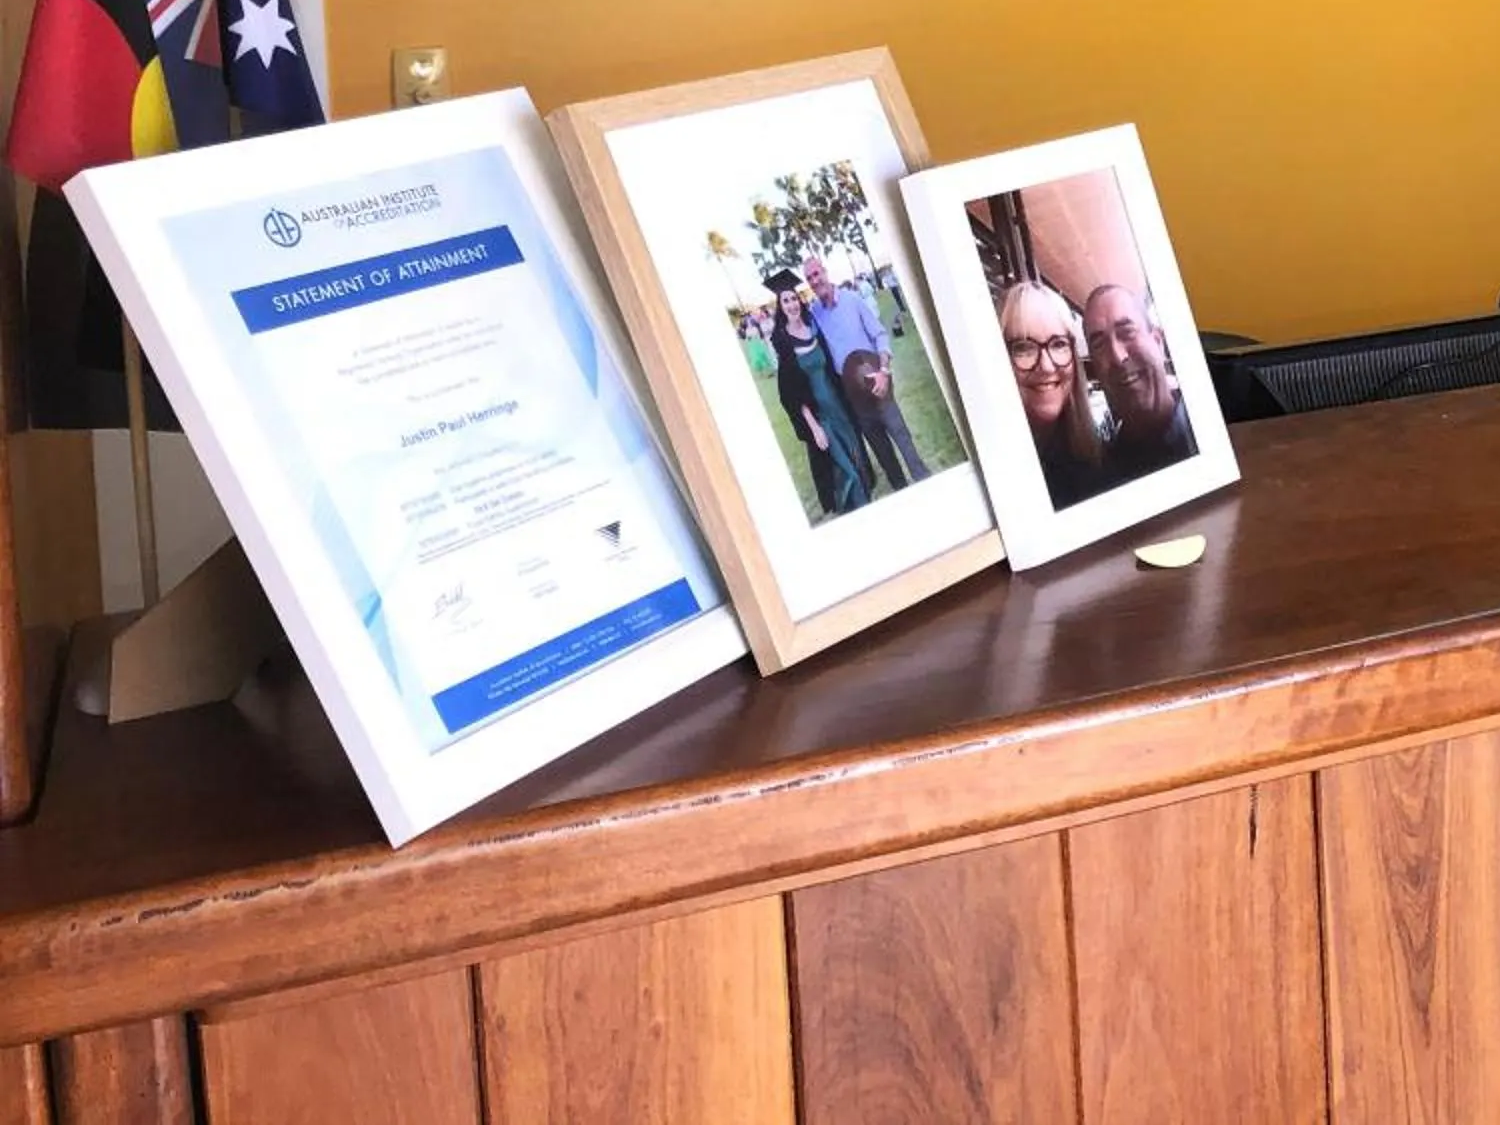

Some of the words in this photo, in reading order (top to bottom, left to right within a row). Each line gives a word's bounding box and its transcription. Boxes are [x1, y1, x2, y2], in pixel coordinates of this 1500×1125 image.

[301, 196, 380, 224] AUSTRALIAN
[382, 183, 440, 207] INSTITUTE
[346, 199, 442, 231] ACCREDITATION
[271, 274, 366, 313] STATEMENT
[369, 266, 392, 287] OF
[398, 243, 489, 280] ATTAINMENT
[400, 426, 439, 448] Justin
[438, 415, 467, 434] Paul
